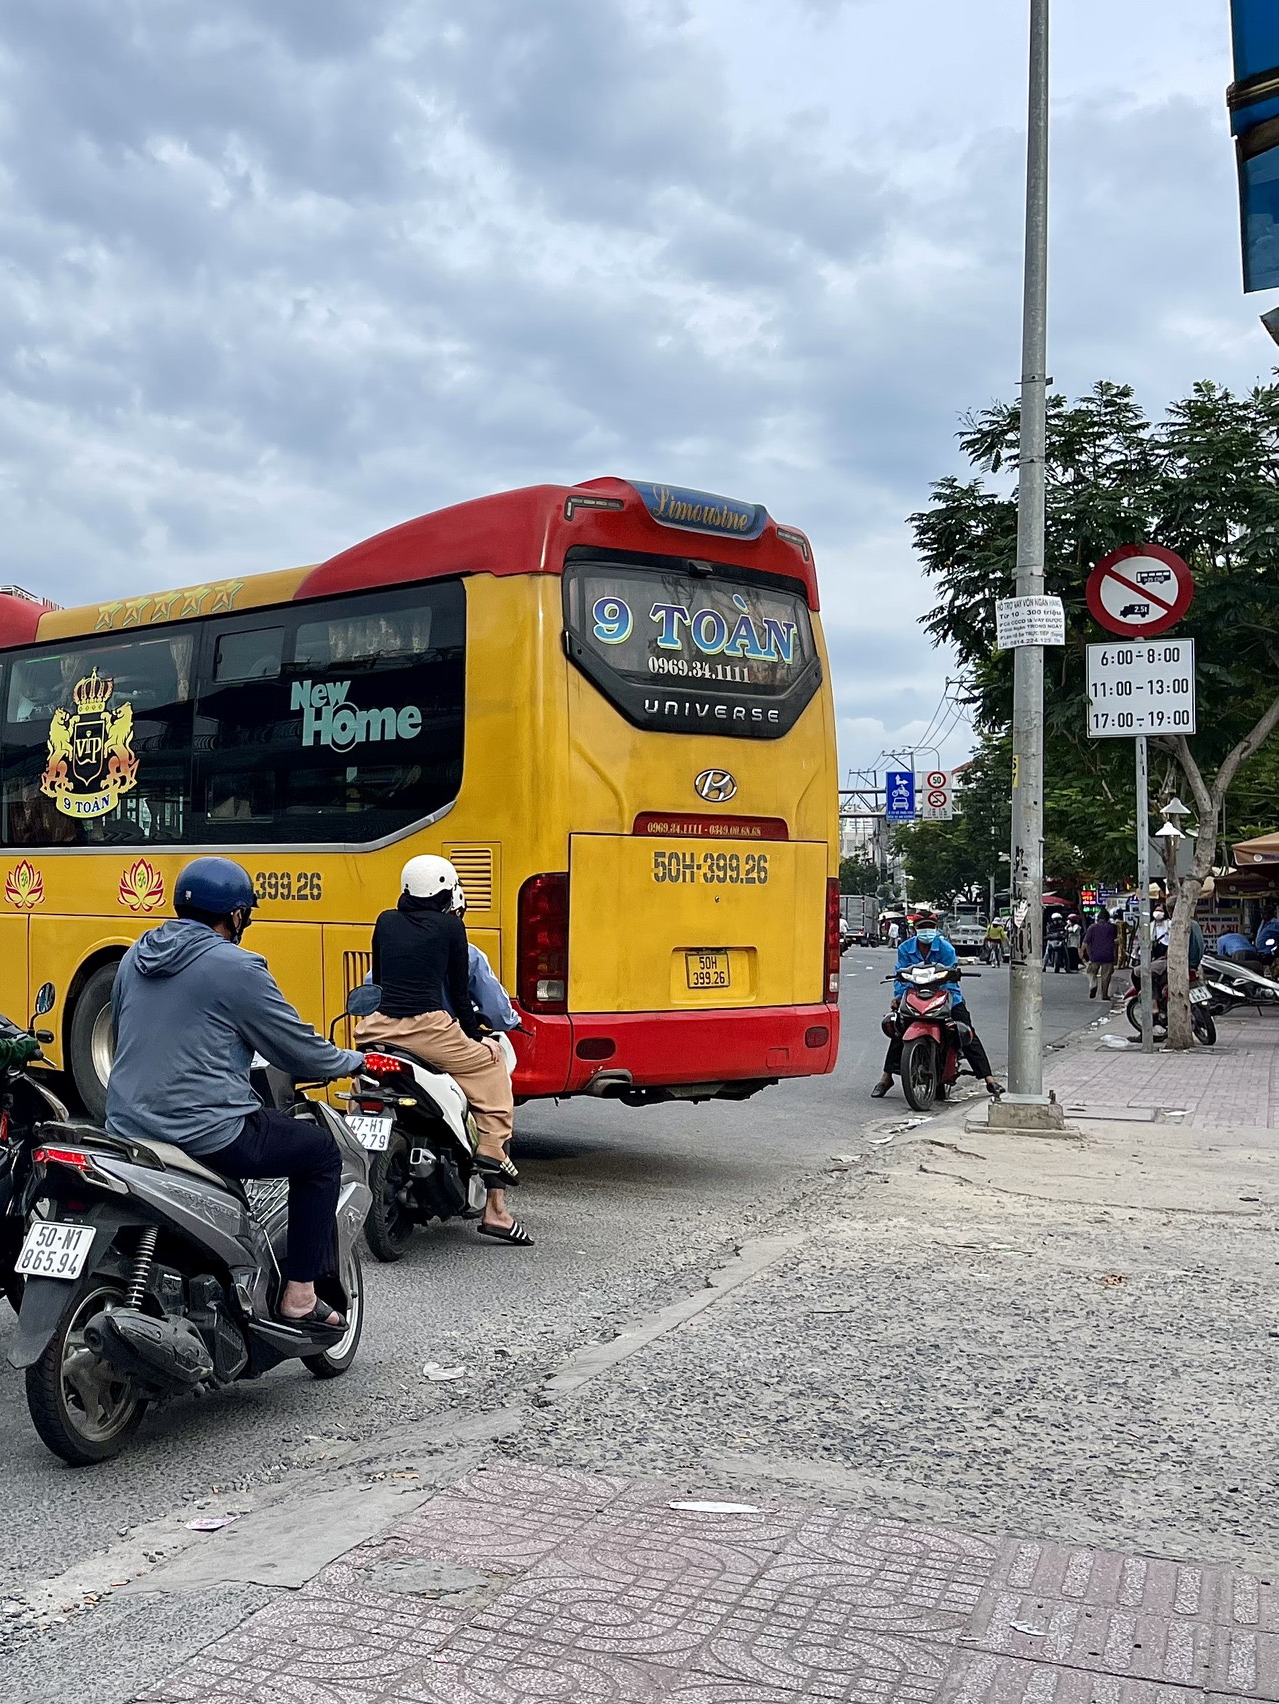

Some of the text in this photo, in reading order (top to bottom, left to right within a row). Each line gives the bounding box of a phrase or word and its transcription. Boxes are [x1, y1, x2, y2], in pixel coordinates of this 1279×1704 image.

[651, 484, 749, 532] Limousine
[592, 594, 797, 665] 9 TOÀN
[648, 656, 750, 683] 0969.34.1111
[290, 680, 351, 710] New
[645, 699, 779, 723] UNIVERSE
[302, 702, 422, 750] Home
[76, 730, 102, 765] VIP
[932, 776, 942, 785] 50
[64, 794, 110, 813] 9 TOÀN
[653, 851, 768, 885] 50H-399.26
[699, 956, 717, 970] 50H
[693, 970, 725, 986] 399.26
[350, 1117, 383, 1133] 47-H1
[355, 1133, 386, 1148] 2.79
[35, 1225, 83, 1251] 50-N1
[21, 1248, 79, 1275] 865.94
